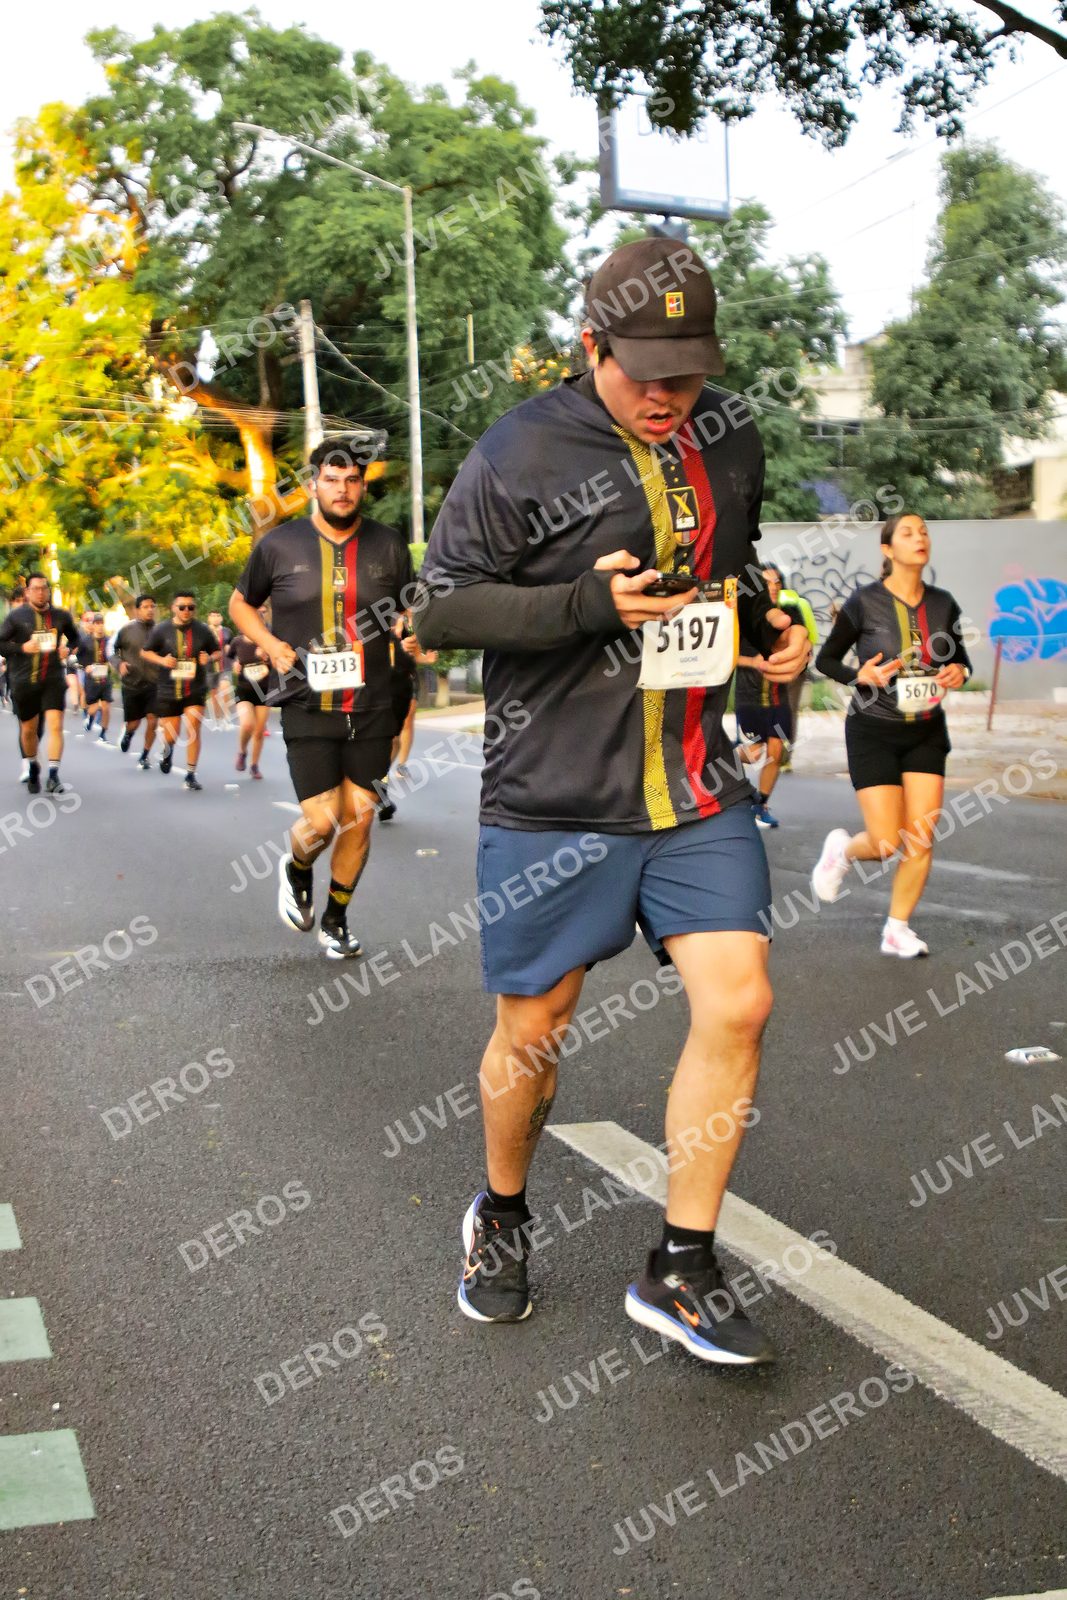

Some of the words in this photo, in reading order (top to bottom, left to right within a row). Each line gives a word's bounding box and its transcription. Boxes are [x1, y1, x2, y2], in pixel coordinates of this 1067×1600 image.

[657, 615, 720, 653] 5197
[312, 657, 357, 675] 12313
[905, 681, 937, 699] 5670
